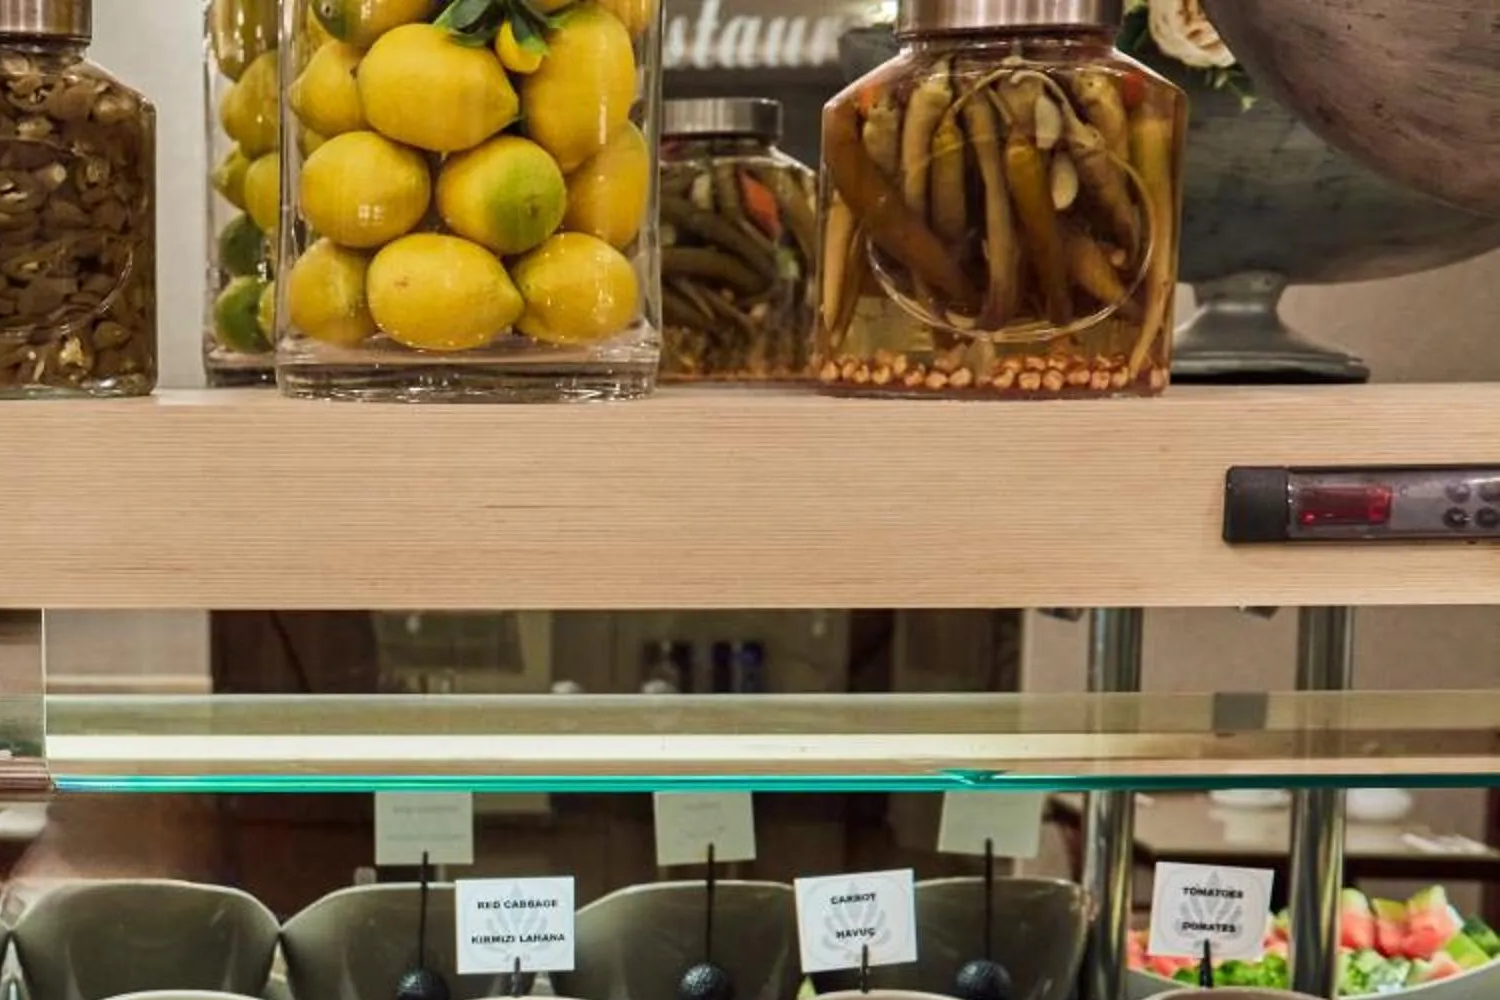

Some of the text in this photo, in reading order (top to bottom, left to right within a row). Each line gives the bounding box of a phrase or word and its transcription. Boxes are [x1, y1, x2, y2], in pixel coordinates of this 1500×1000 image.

[1183, 887, 1244, 899] TOMATOES
[478, 899, 558, 909] RED CABBAGE
[831, 893, 877, 905] CARROT
[836, 927, 876, 938] HAVUÇ
[1182, 922, 1236, 933] DOMATES
[519, 933, 565, 943] LAHANA
